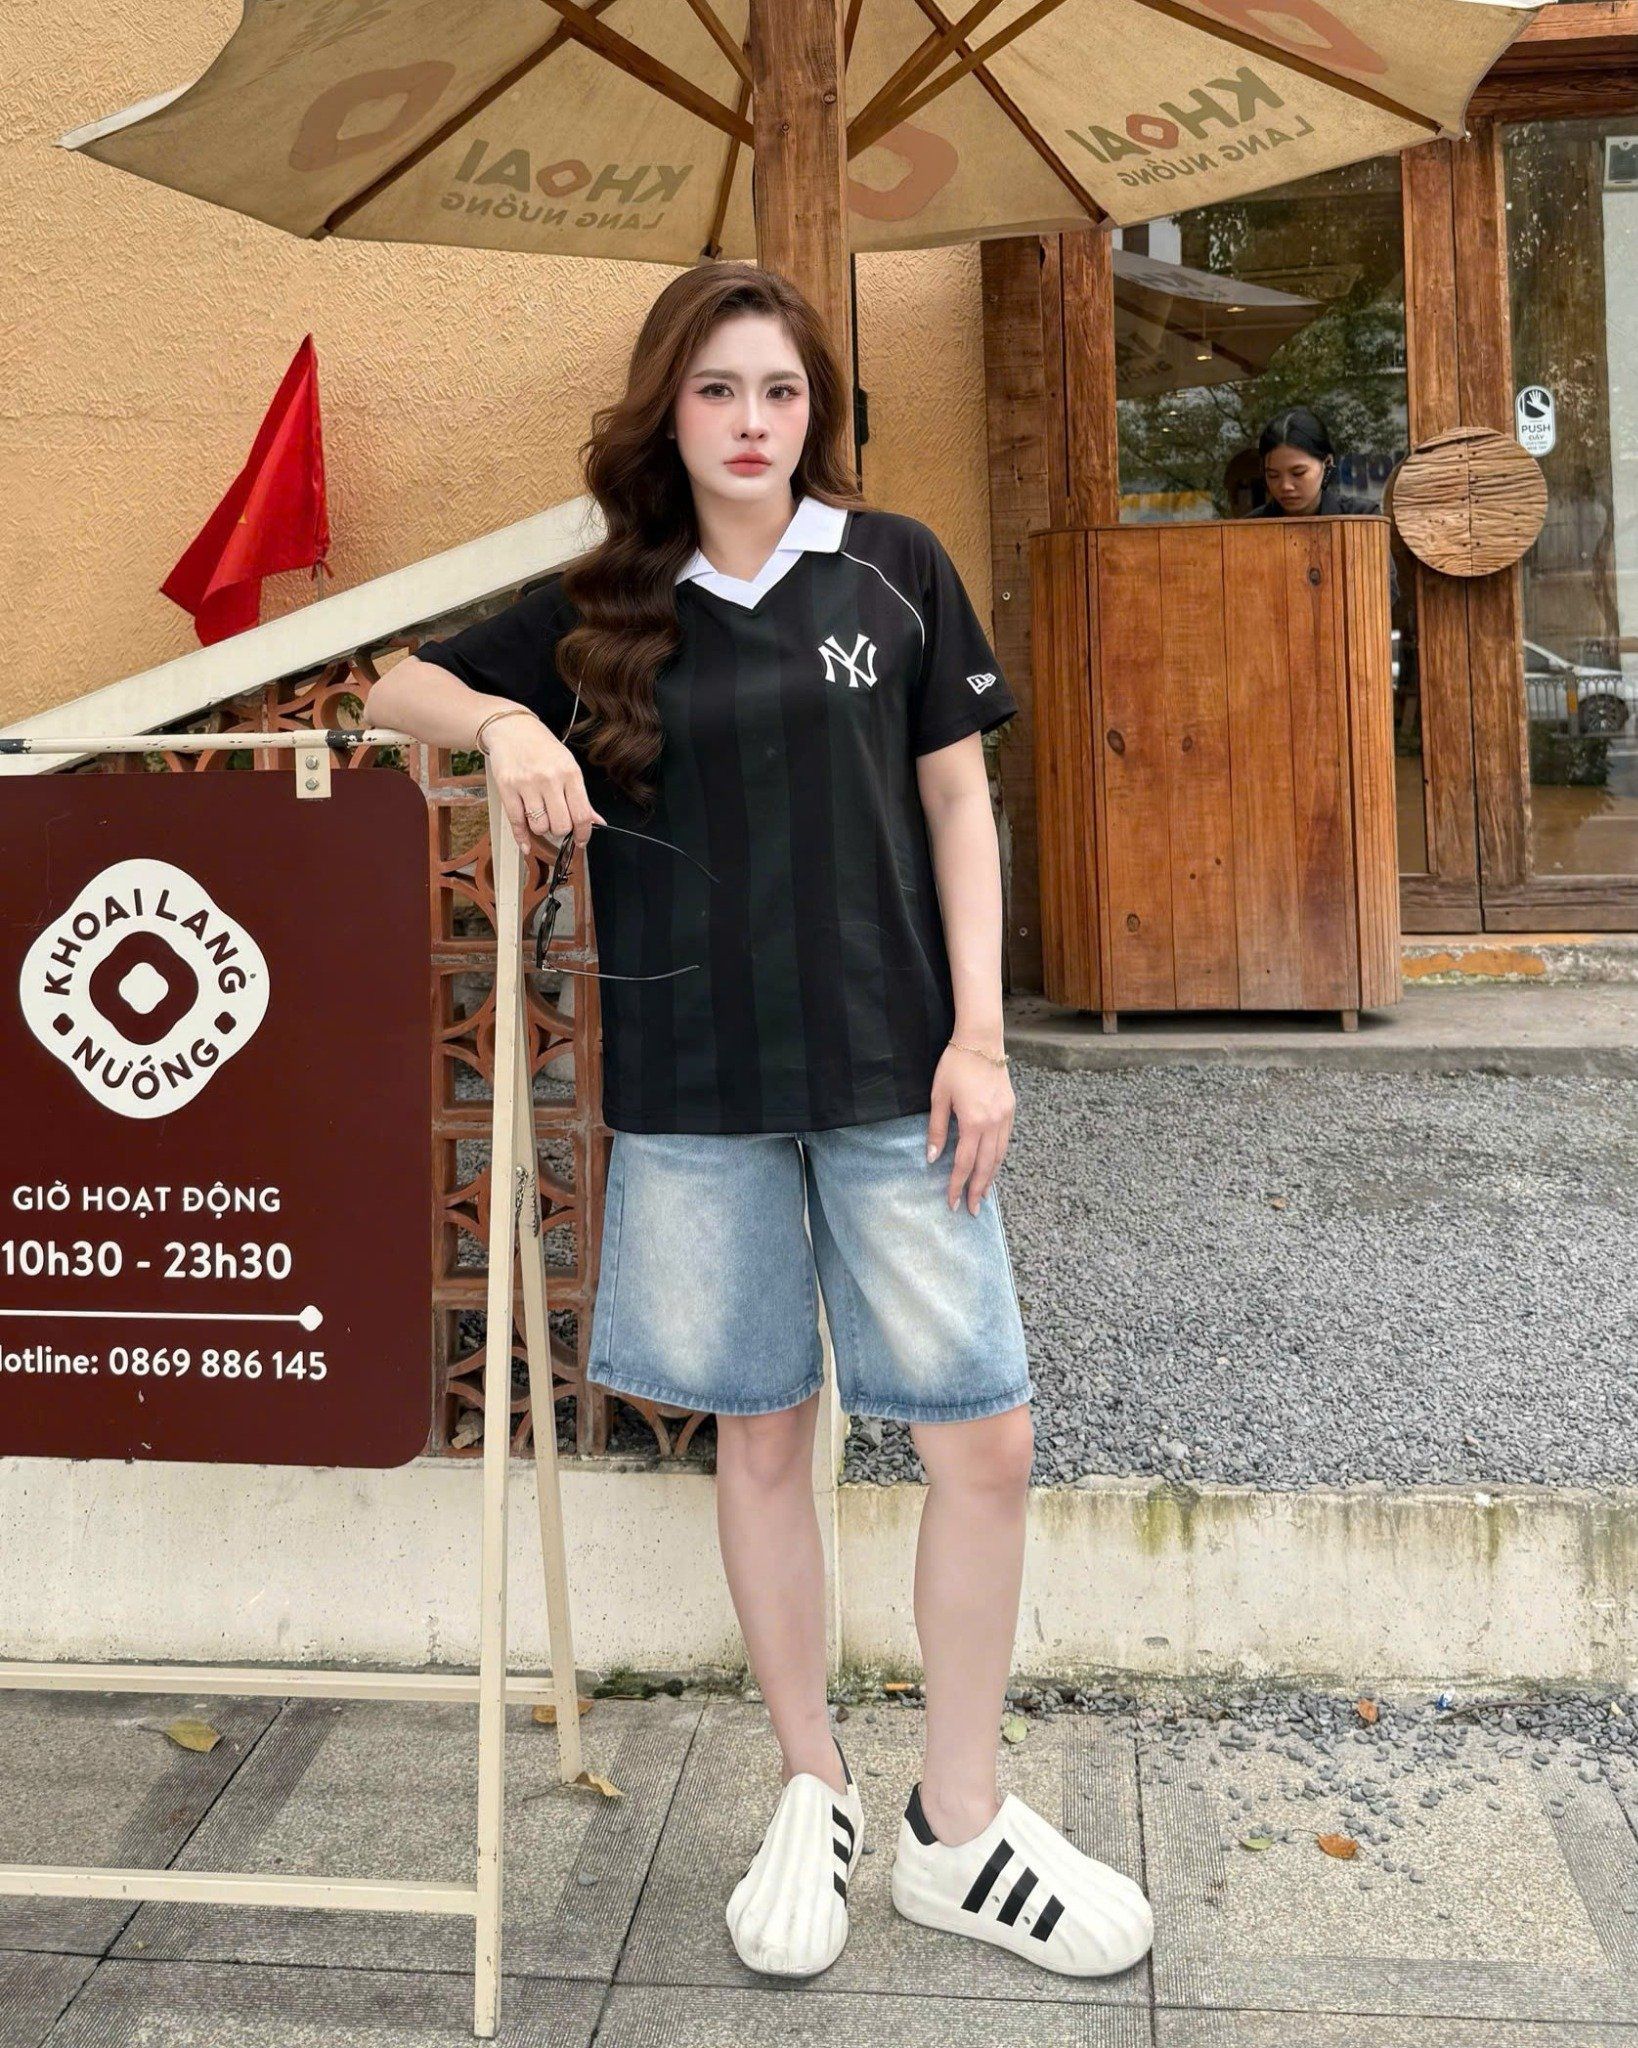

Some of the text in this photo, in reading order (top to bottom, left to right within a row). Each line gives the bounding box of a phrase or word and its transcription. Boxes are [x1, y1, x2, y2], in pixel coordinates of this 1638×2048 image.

[1521, 424, 1551, 434] PUSH
[817, 633, 878, 688] NY
[44, 888, 247, 996] KHOAI LANG
[71, 1037, 220, 1100] NƯỚNG
[12, 1180, 281, 1219] GIỜ HOẠT ĐỘNG
[1, 1240, 123, 1278] 10h30
[164, 1241, 292, 1280] 23h30
[0, 1344, 328, 1381] otline: 0869 886 145
